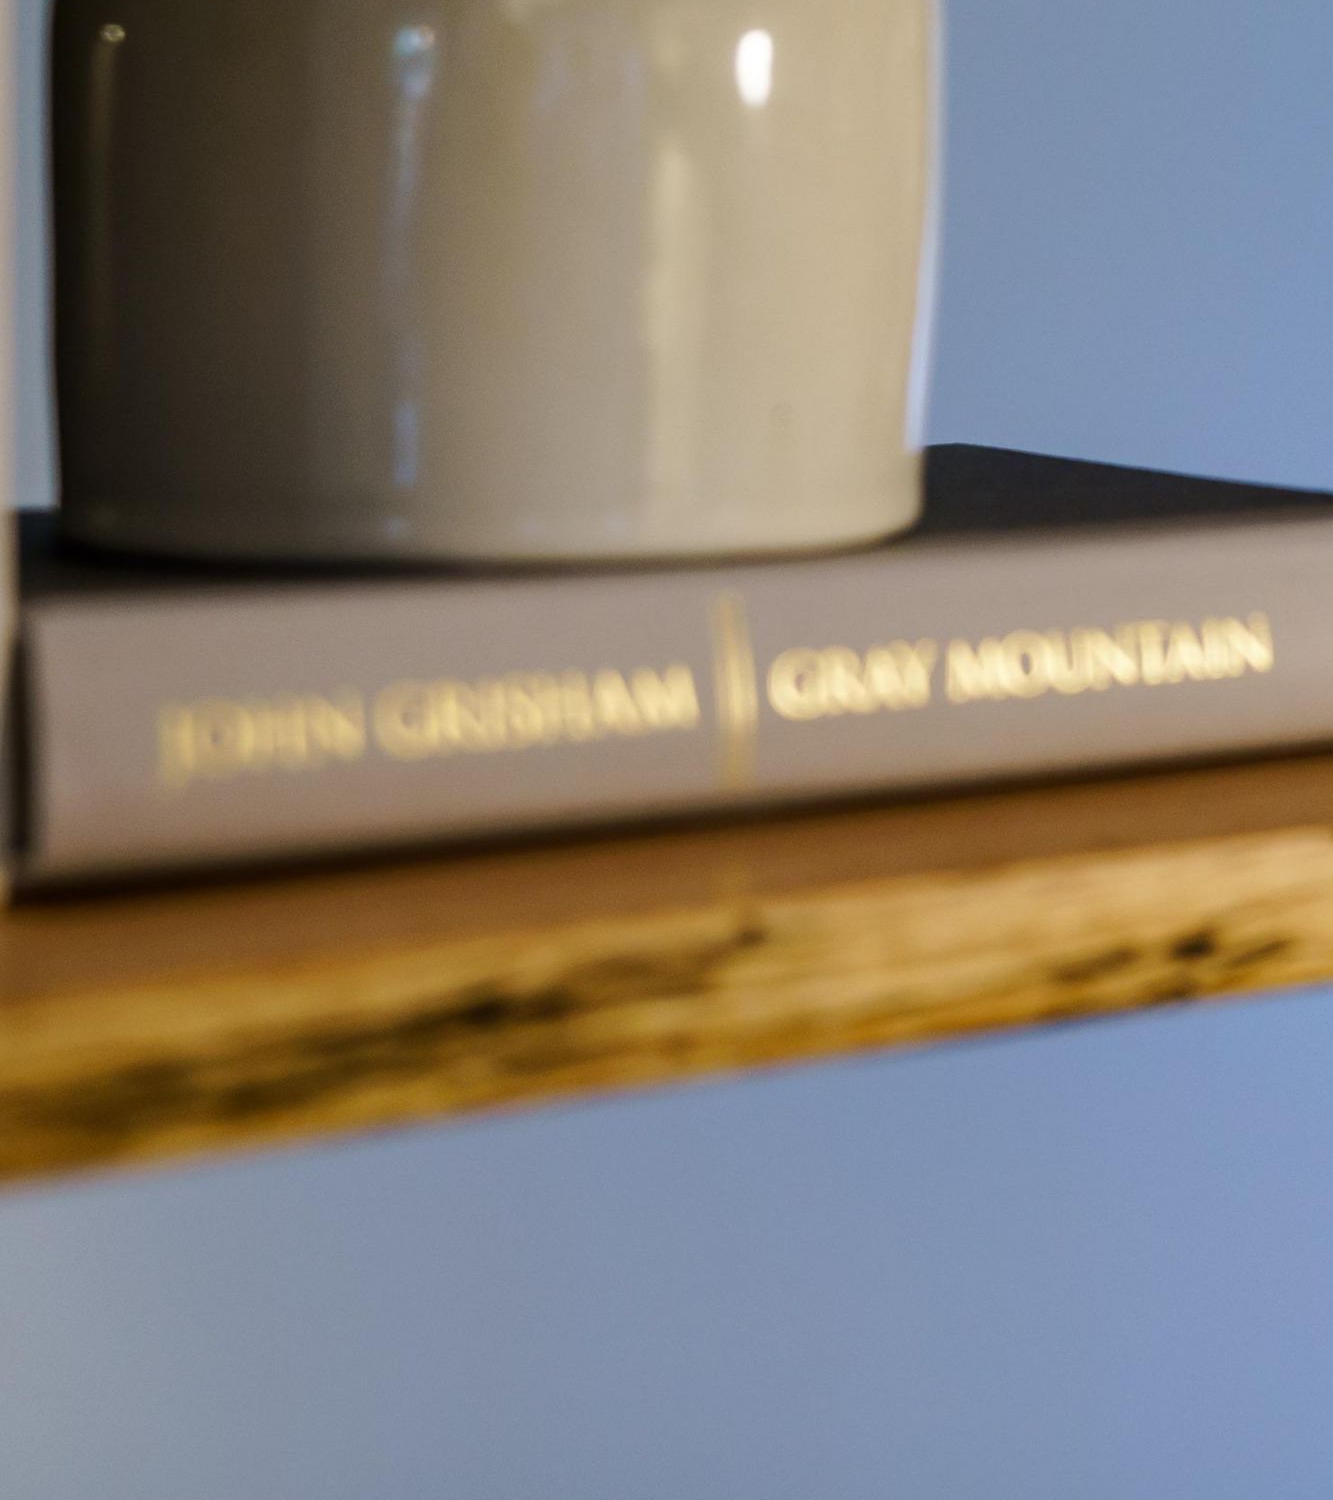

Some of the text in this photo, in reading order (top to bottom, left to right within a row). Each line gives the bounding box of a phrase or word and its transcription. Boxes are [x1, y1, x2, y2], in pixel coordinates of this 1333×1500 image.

[156, 611, 1275, 790] JOHN GRISHAM GRAY MOUNTAIN
